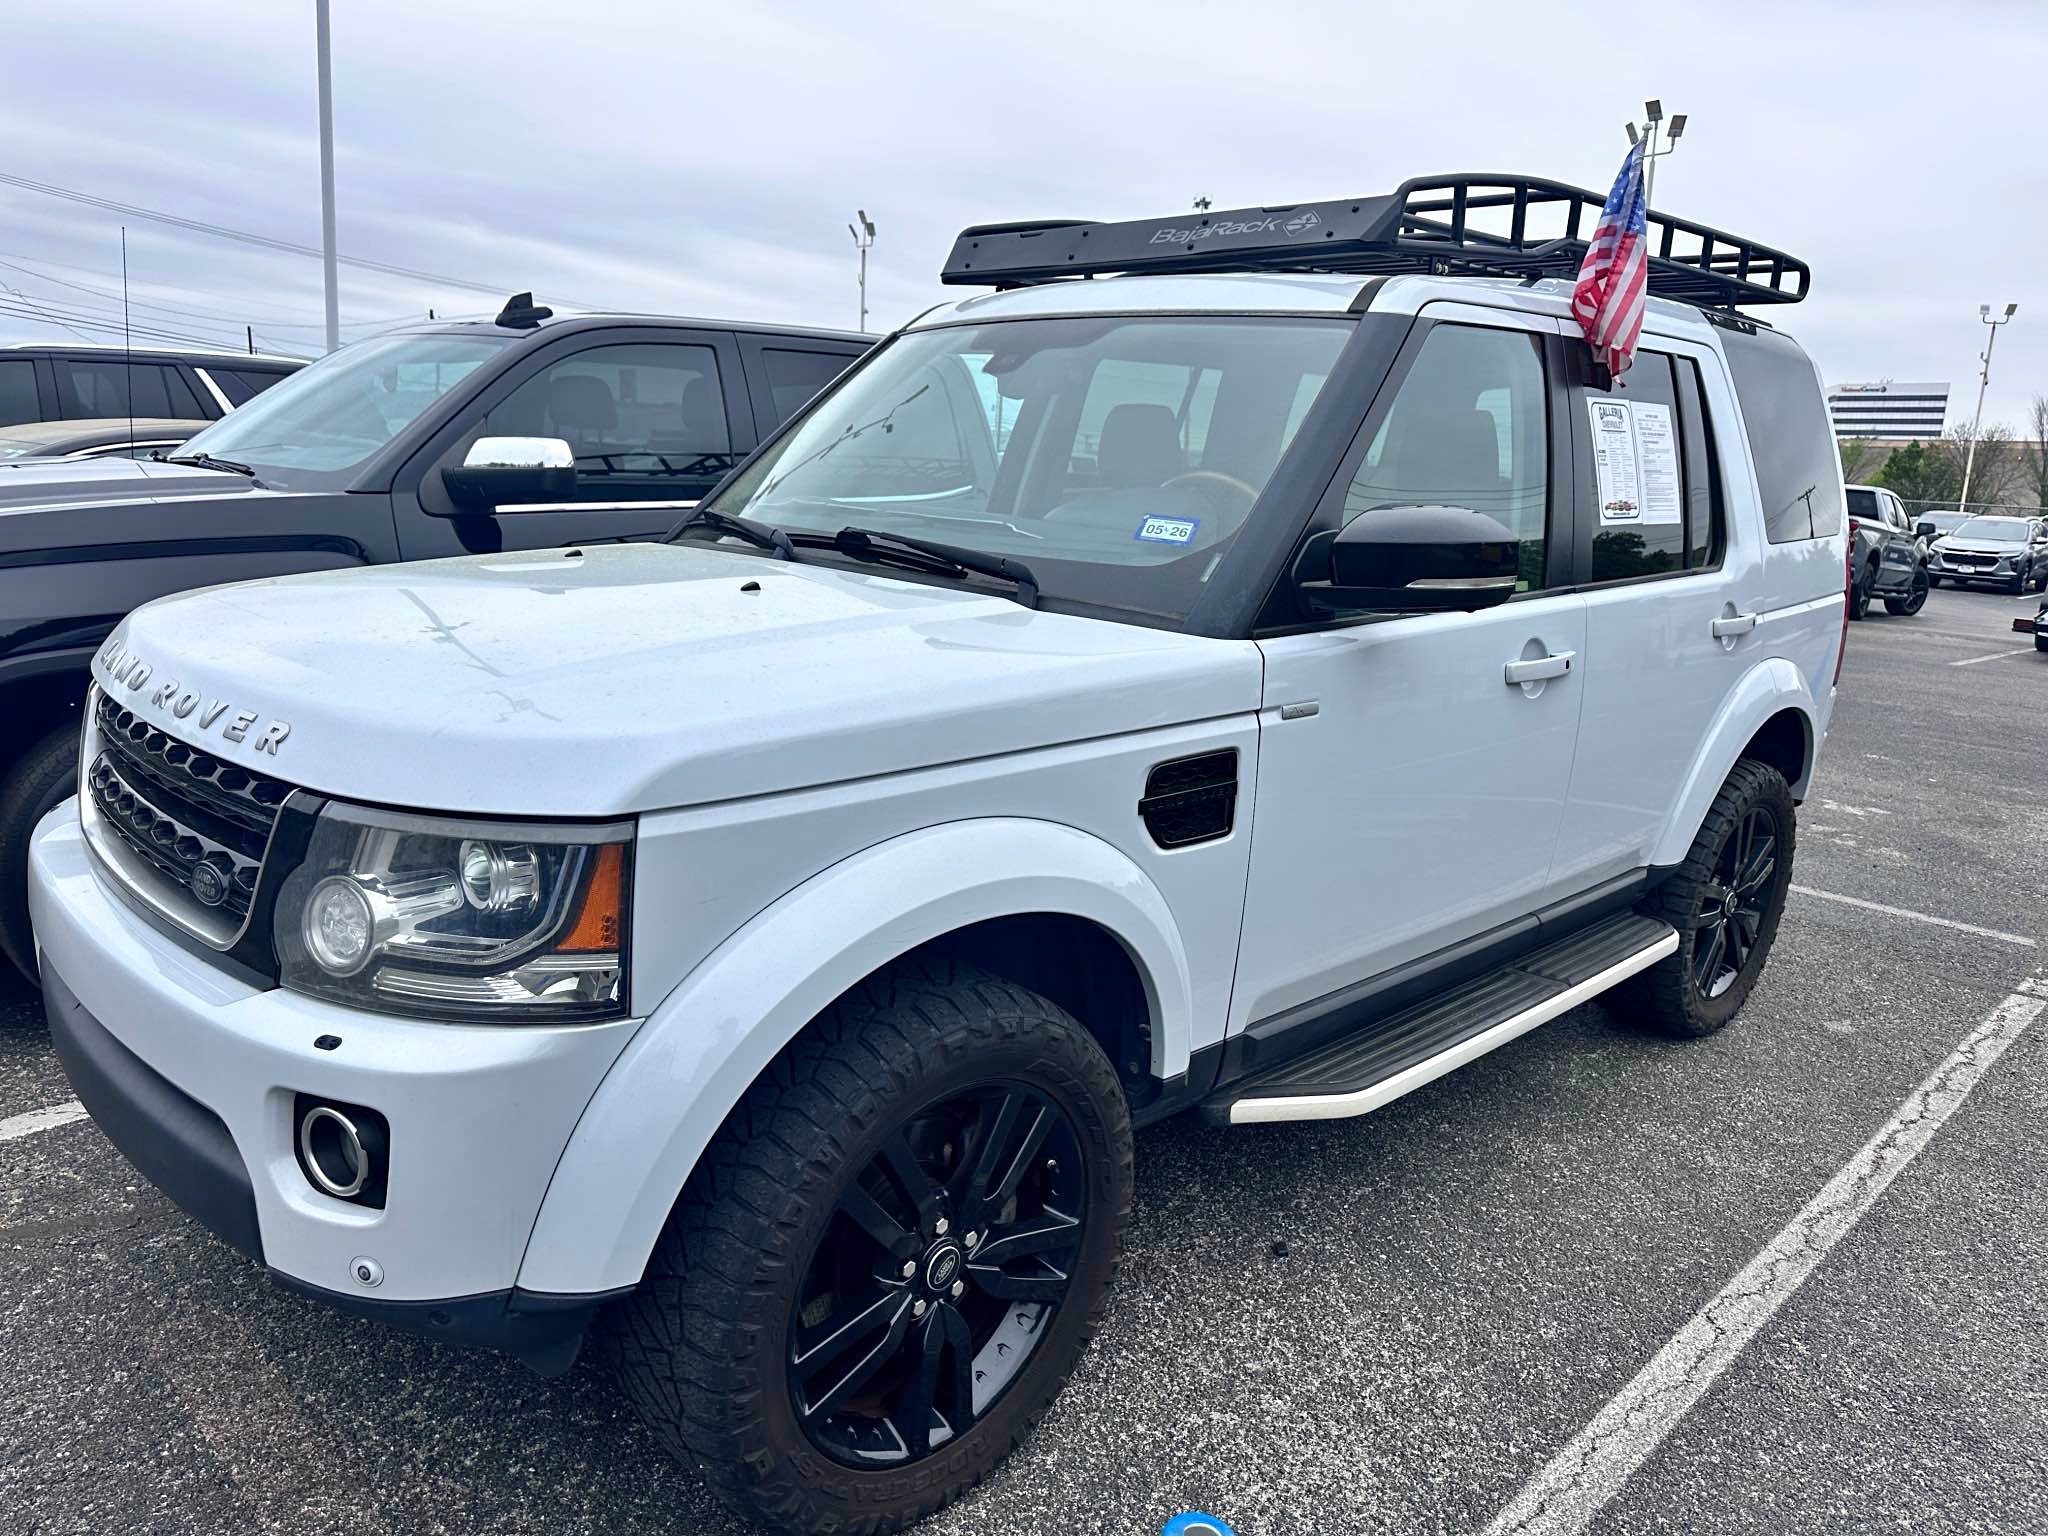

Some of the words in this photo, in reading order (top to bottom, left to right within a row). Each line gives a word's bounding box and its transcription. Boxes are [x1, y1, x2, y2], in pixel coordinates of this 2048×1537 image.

[1149, 217, 1282, 244] BajaRack
[1146, 524, 1163, 534] 05
[1169, 526, 1188, 537] 26
[100, 639, 153, 691] LAND
[151, 678, 291, 756] ROVER
